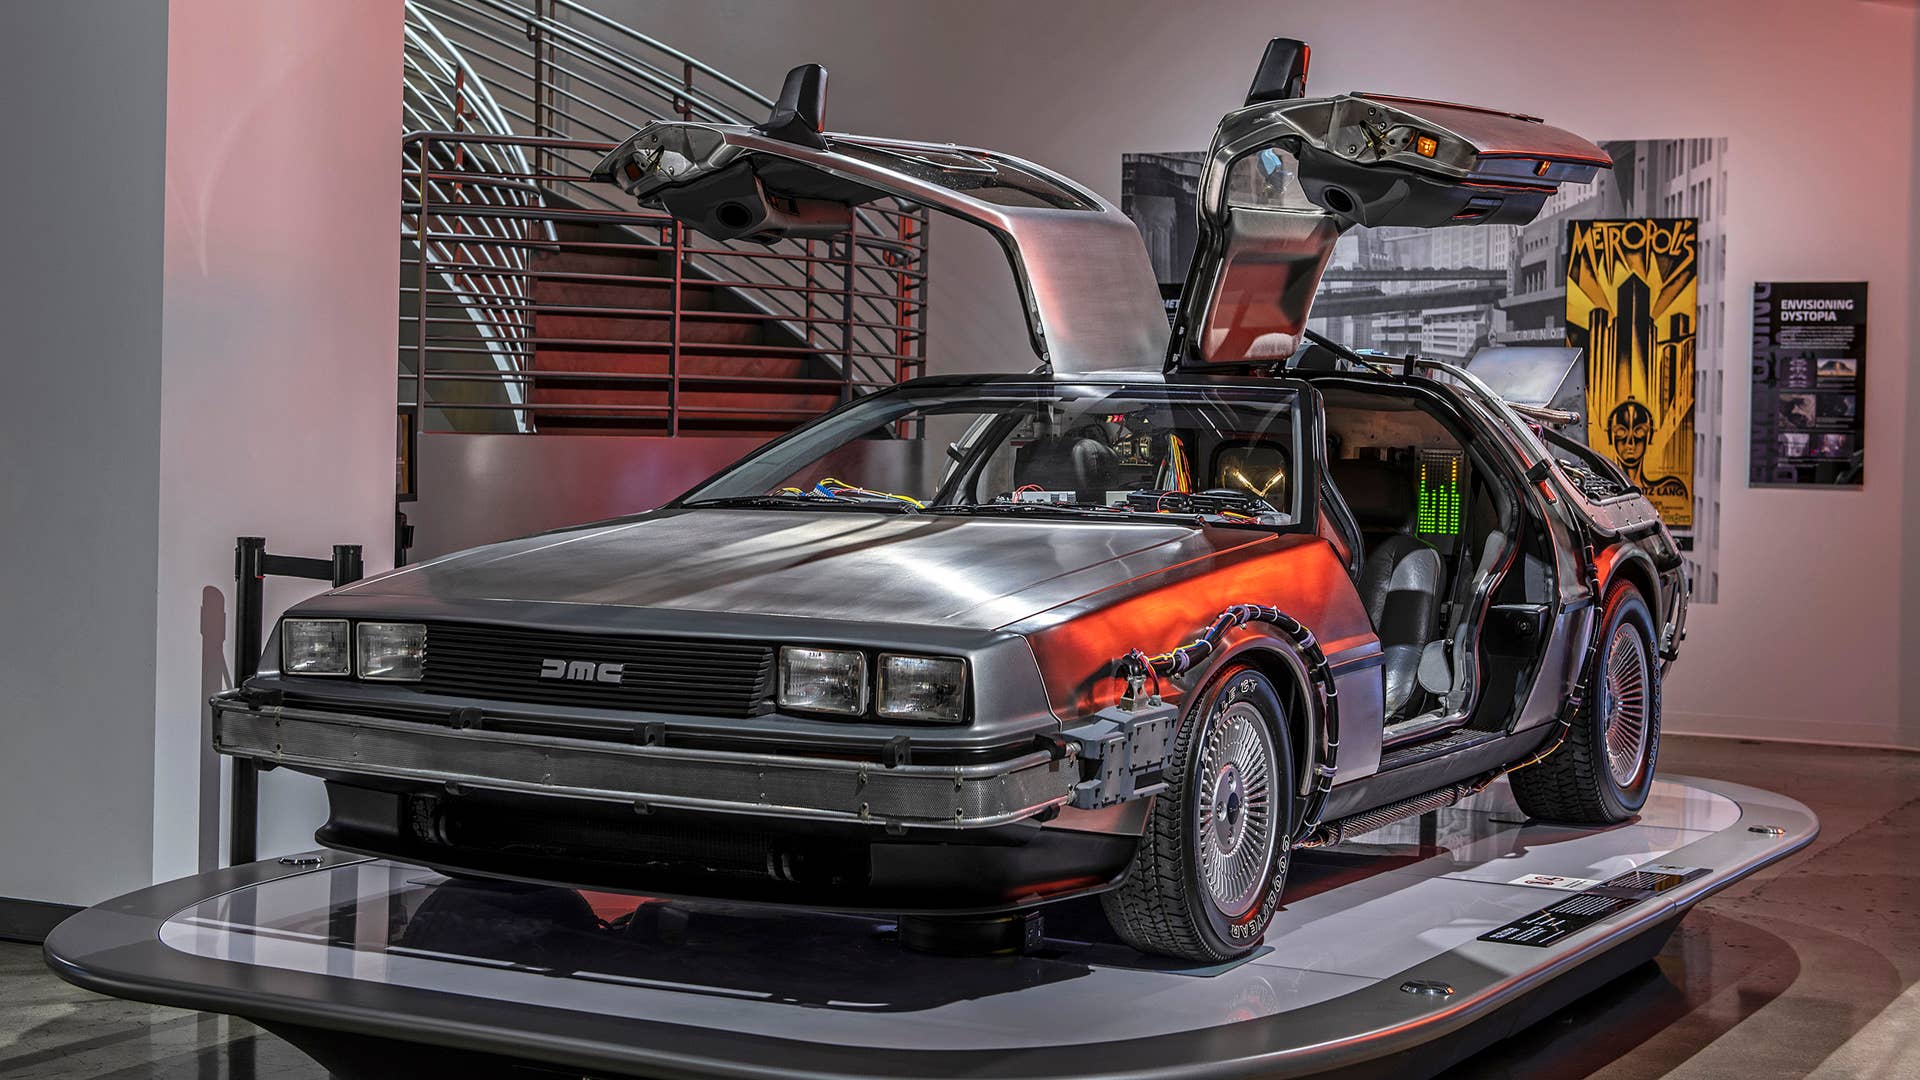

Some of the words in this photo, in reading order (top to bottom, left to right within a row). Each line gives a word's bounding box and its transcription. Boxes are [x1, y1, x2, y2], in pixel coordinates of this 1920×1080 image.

[1568, 219, 1695, 286] METROPOLIS
[1781, 299, 1854, 310] ENVISIONING
[1781, 311, 1837, 321] DYSTOPIA
[1657, 487, 1684, 496] LANG
[541, 659, 623, 683] DMC
[1231, 834, 1290, 938] GOODYEAR
